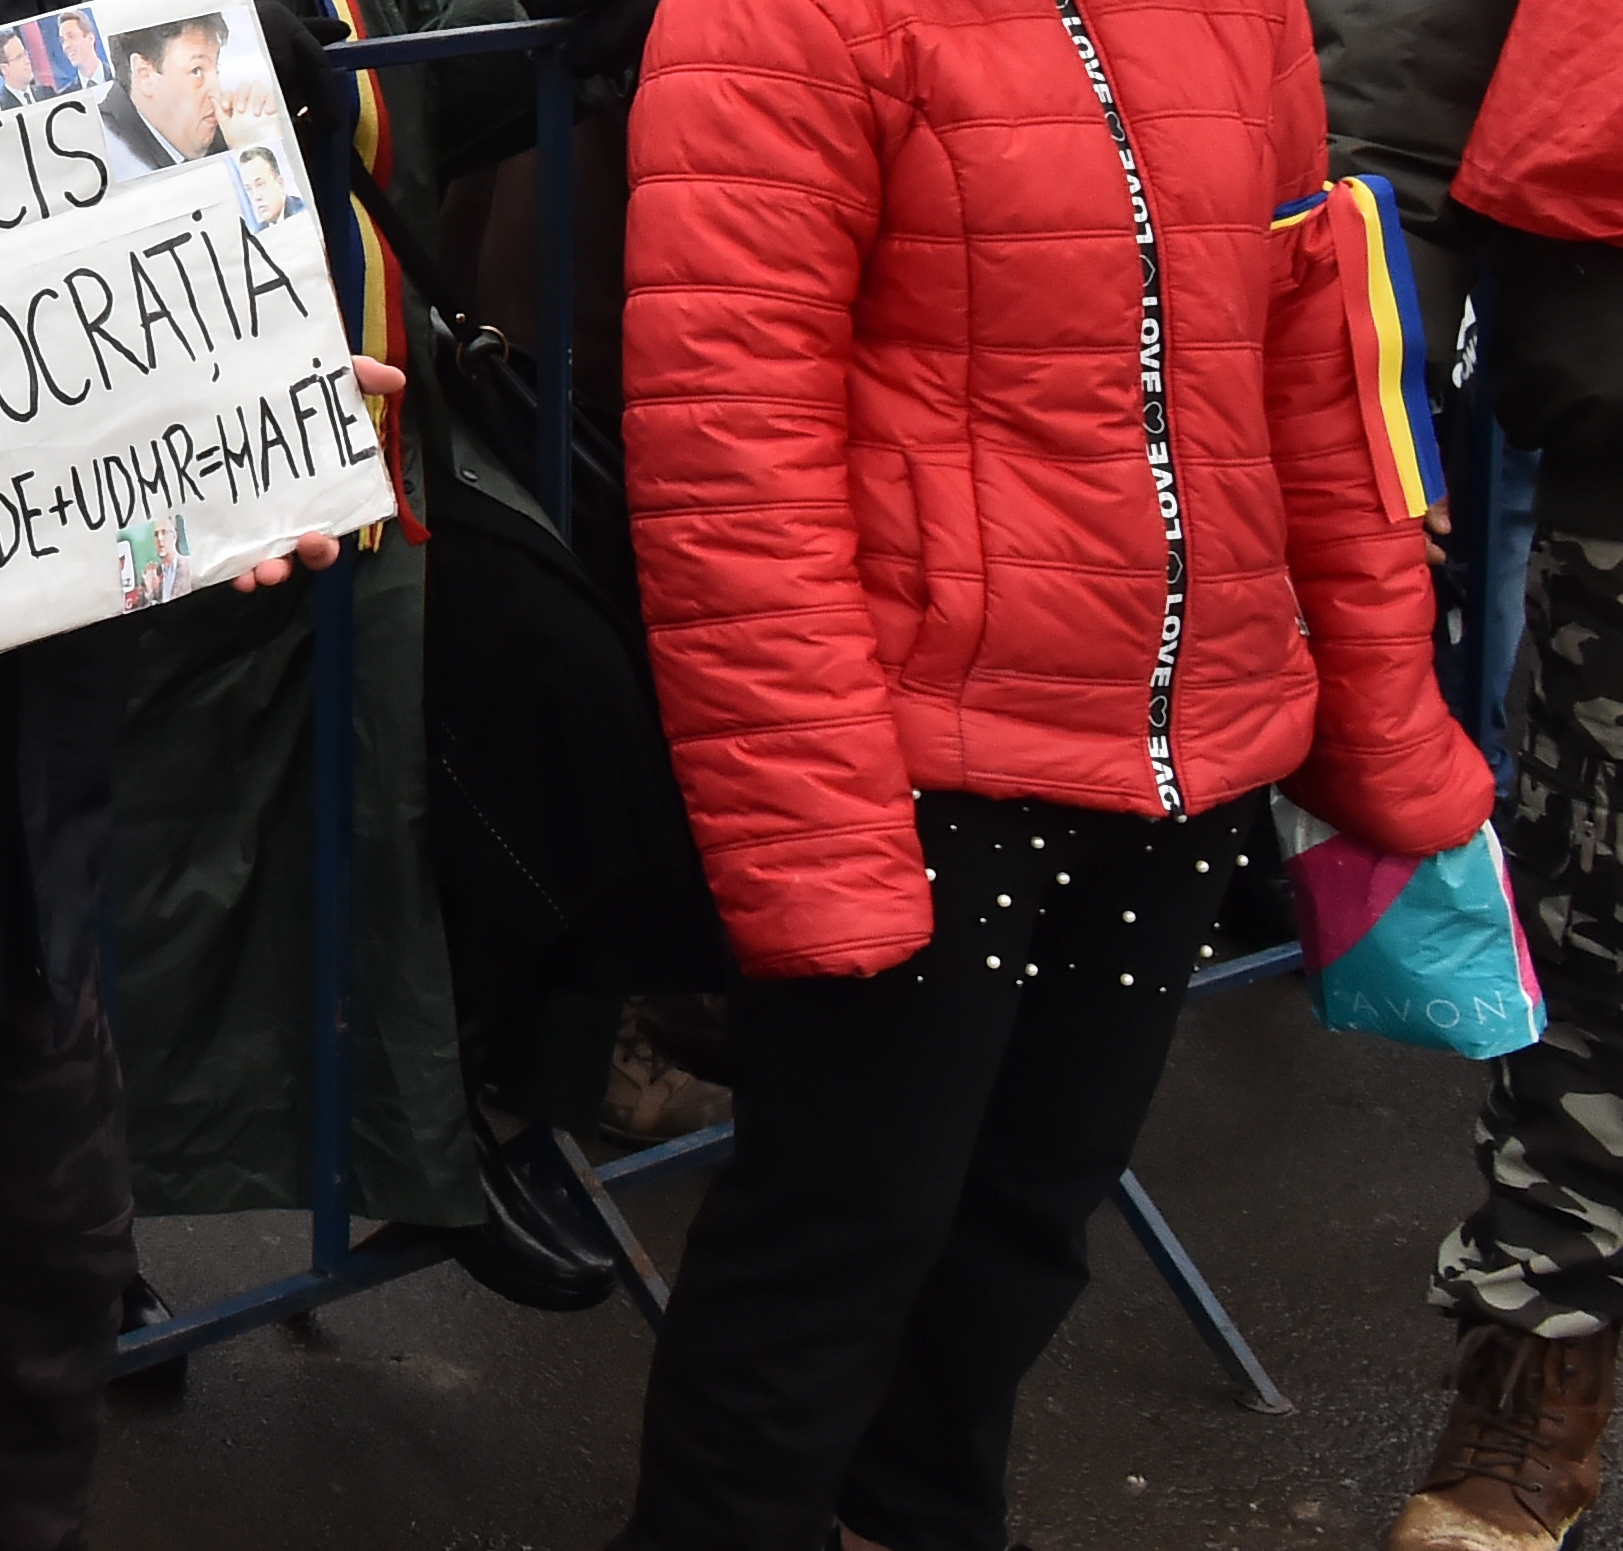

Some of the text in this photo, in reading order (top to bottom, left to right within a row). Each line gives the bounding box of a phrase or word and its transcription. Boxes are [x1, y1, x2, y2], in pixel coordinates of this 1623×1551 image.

[1061, 16, 1114, 105] LOVE
[1118, 148, 1155, 245] LOVE
[1145, 440, 1184, 541] LOVE
[1149, 593, 1184, 688] LOVE
[1147, 734, 1182, 813] OVE
[1354, 990, 1507, 1030] AVON
